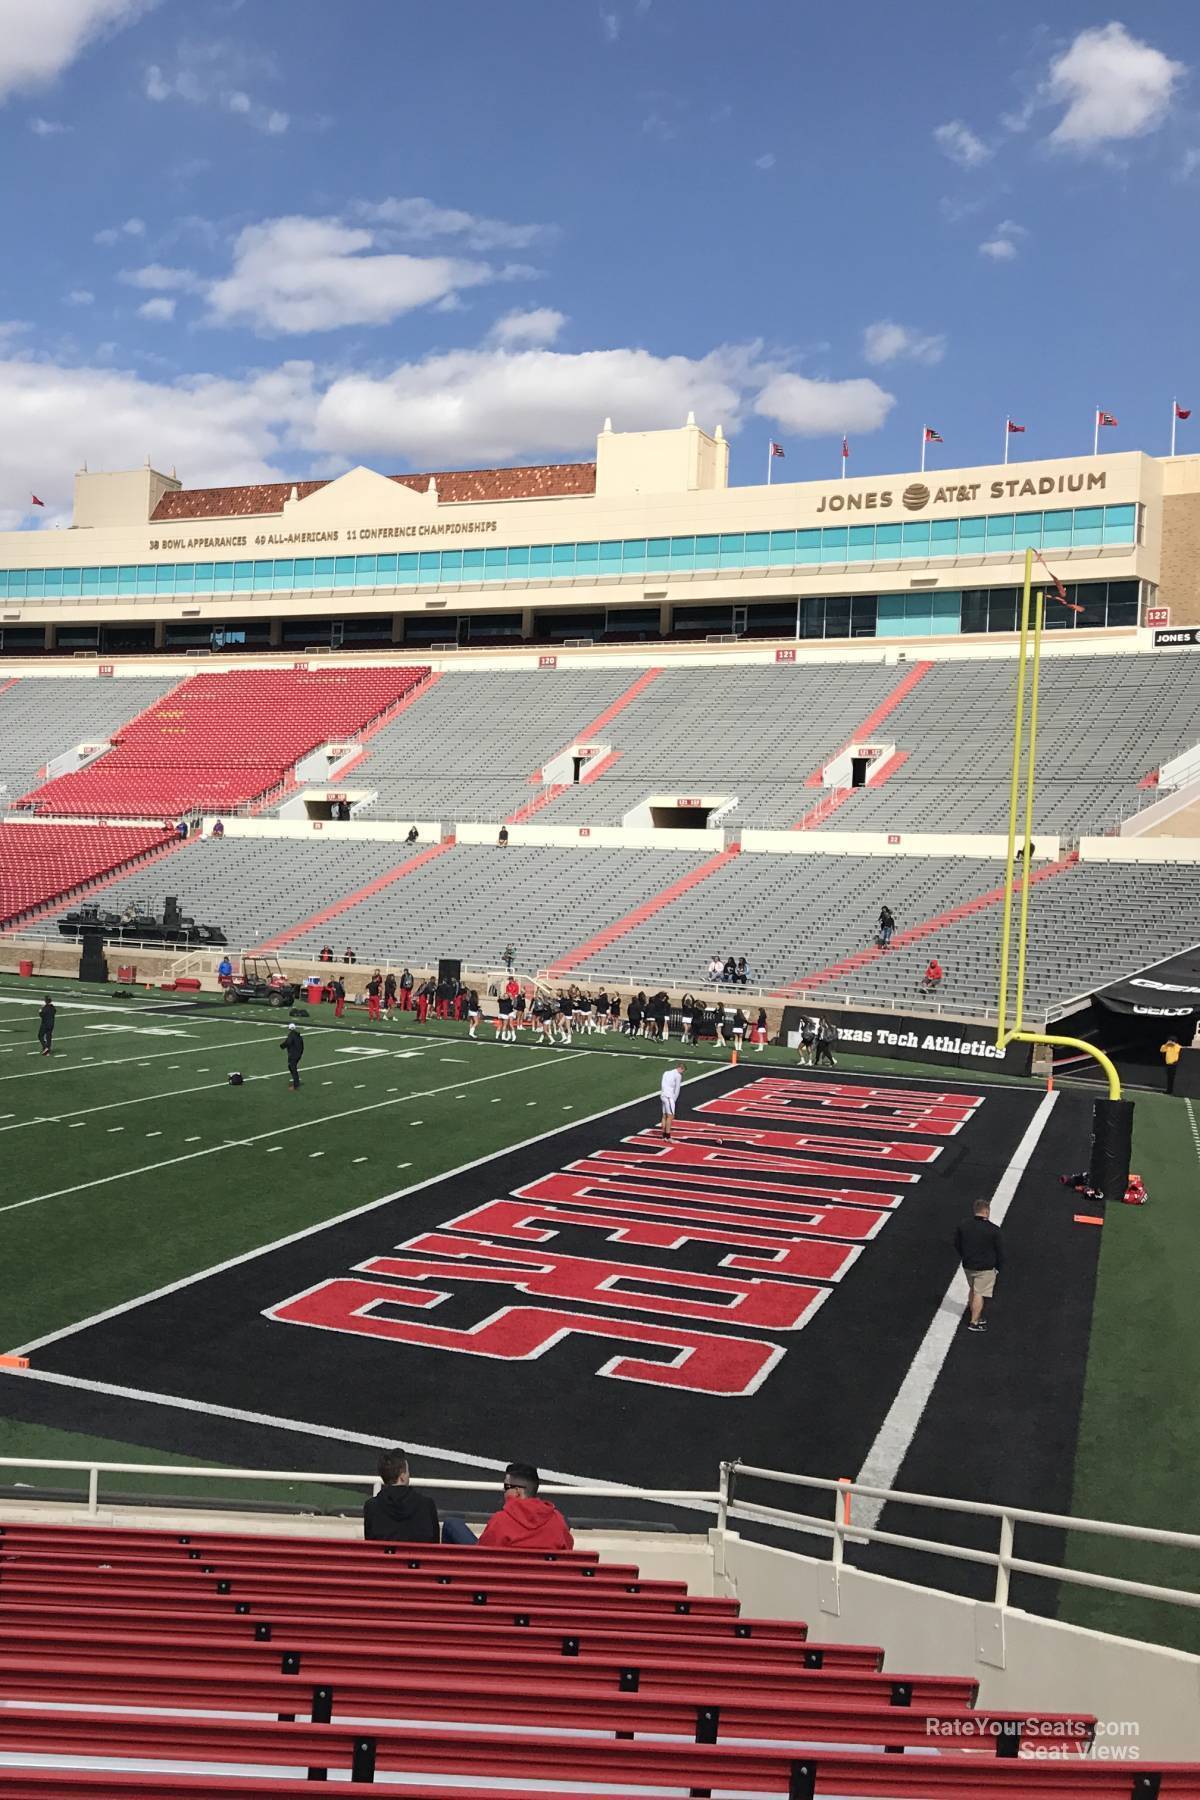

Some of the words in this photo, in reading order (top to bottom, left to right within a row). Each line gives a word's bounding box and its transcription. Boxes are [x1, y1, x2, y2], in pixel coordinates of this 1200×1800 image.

[816, 491, 893, 513] JONES
[933, 483, 981, 504] AT&T
[990, 471, 1107, 499] STADIUM
[268, 531, 339, 545] ALL-AMERICANS
[346, 530, 357, 541] 11
[359, 526, 417, 540] CONFERENCE
[418, 521, 498, 536] CHAMPIONSHIPS
[162, 538, 186, 550] BOWL
[187, 536, 247, 549] APPEARANCES
[1149, 611, 1168, 620] 122
[1156, 633, 1191, 643] JONES
[541, 656, 555, 665] 120
[1133, 1005, 1194, 1016] GEICO
[876, 1029, 919, 1049] Tech
[920, 1035, 1007, 1059] Athletics
[693, 1077, 986, 1136] RED
[260, 1120, 944, 1396] RAIDERS
